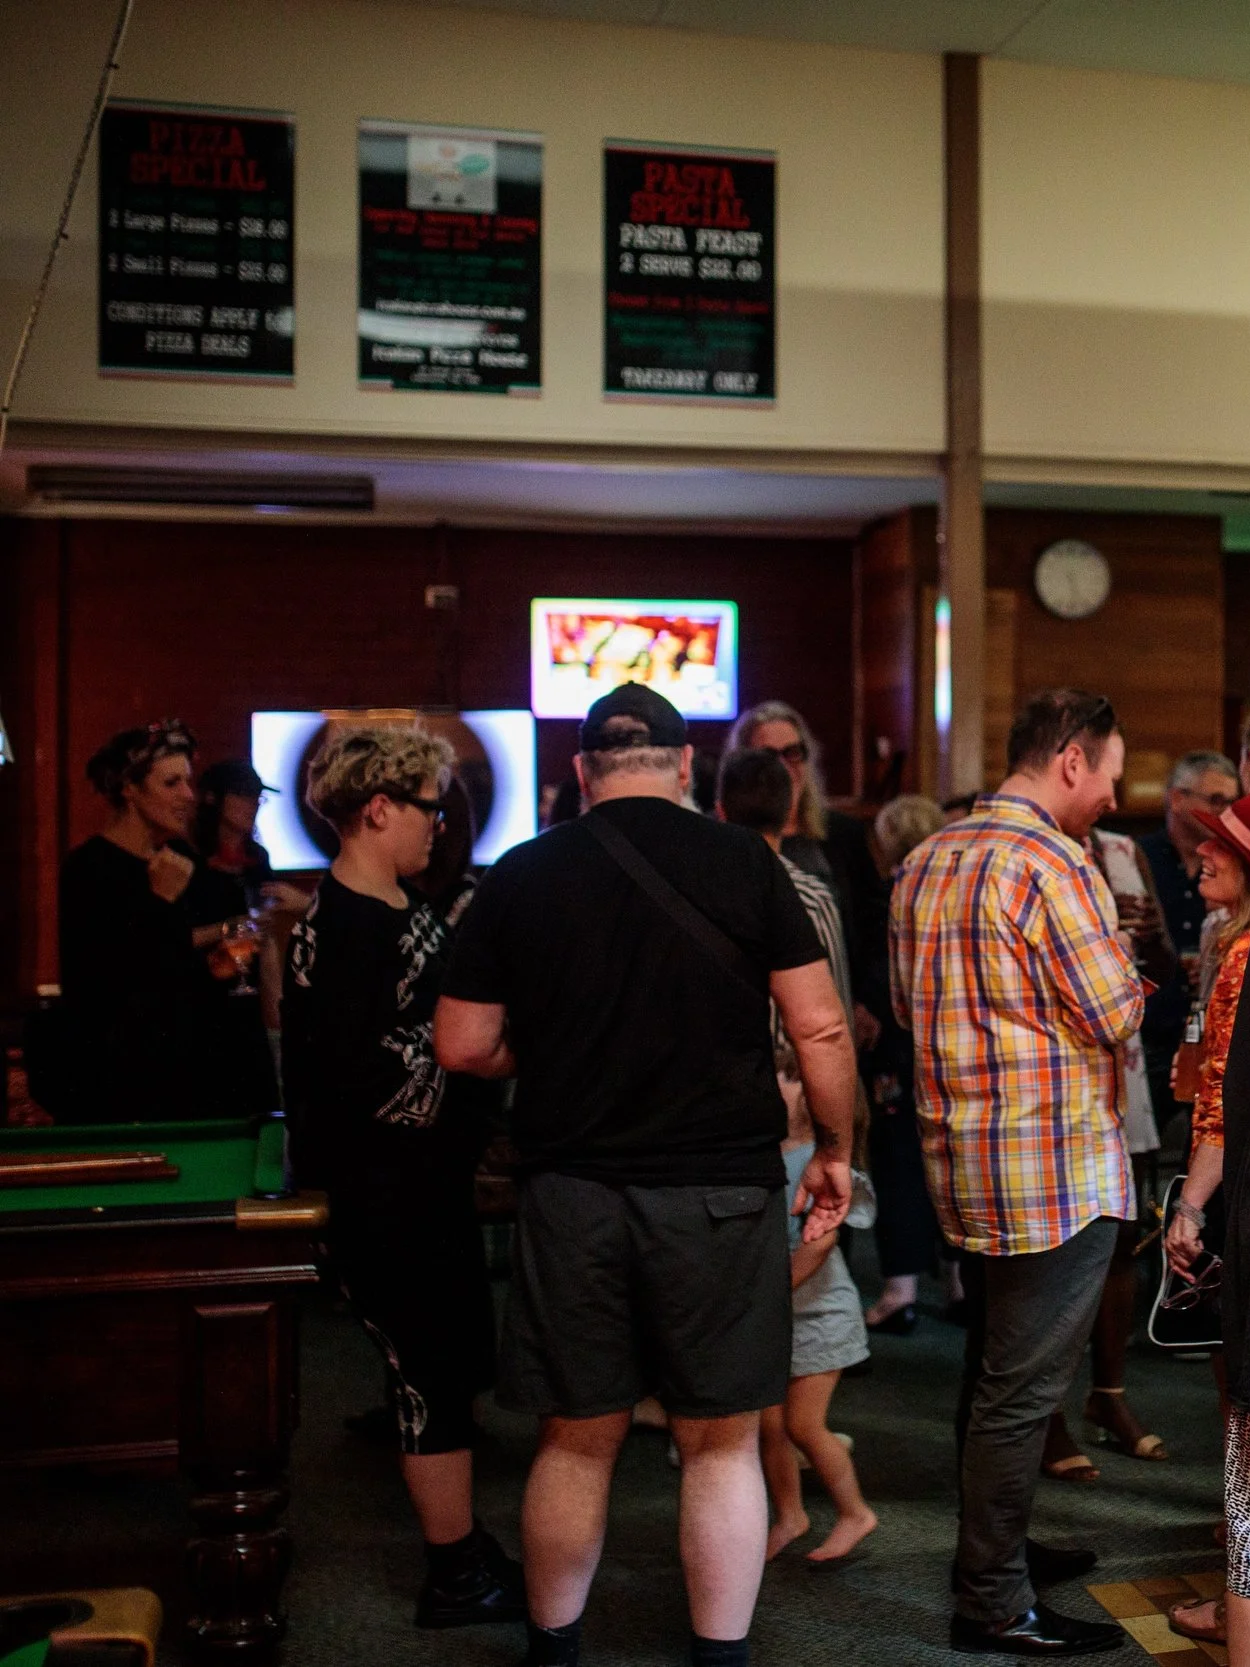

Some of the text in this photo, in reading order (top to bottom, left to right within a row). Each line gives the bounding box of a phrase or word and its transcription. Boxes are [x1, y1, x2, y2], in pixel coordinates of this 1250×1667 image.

[148, 120, 246, 157] PIZZA
[130, 152, 267, 192] SPECIAL
[643, 161, 736, 197] PASTA
[630, 191, 750, 229] SPECIAL
[619, 222, 764, 257] PASTA FEAST
[123, 254, 165, 276] Small
[619, 252, 635, 274] 2
[639, 254, 694, 278] SERVE
[107, 299, 204, 328] CONDITIONS
[210, 307, 261, 331] APPLY
[145, 331, 252, 359] PIZZA DEALS
[620, 365, 759, 394] TAKEAWAY ONLY
